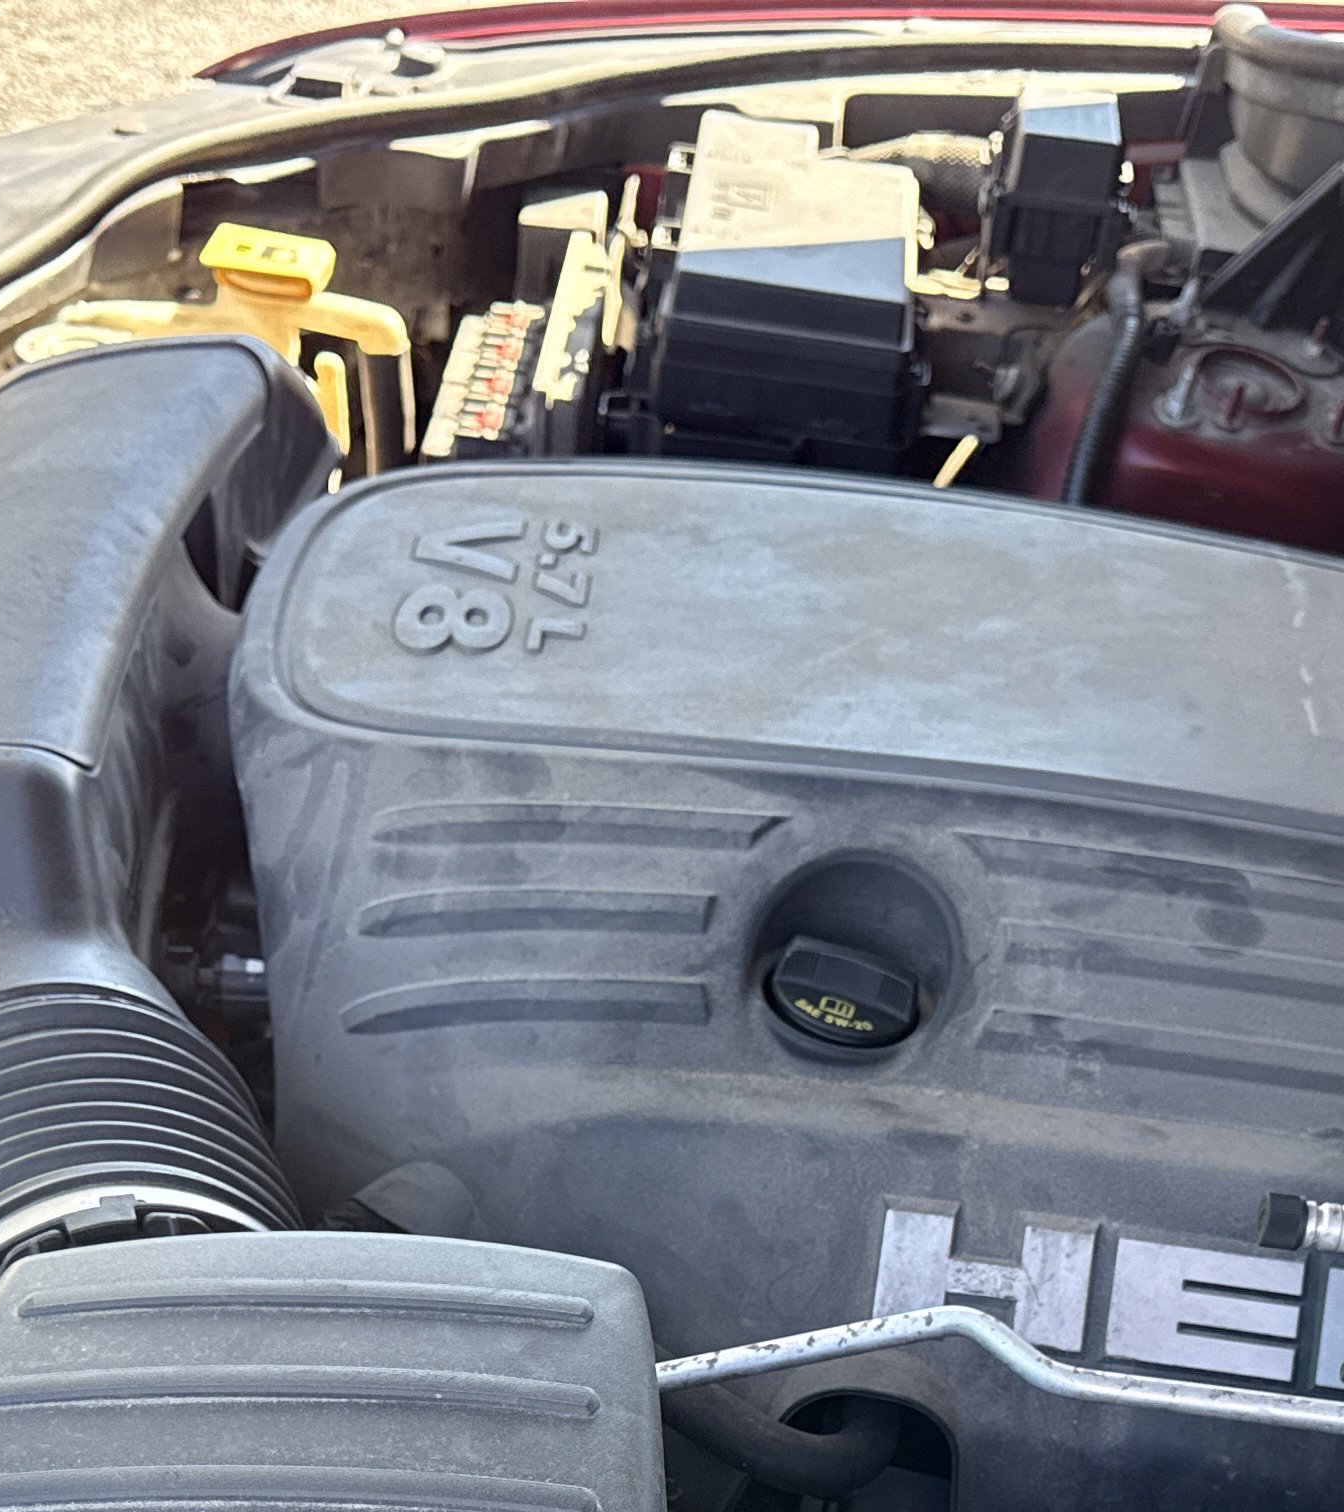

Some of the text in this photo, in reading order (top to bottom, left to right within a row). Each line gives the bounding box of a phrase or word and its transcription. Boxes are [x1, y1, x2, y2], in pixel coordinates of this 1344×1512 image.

[395, 514, 527, 655] V8
[526, 519, 596, 654] 5.7L
[794, 998, 822, 1018] SAE
